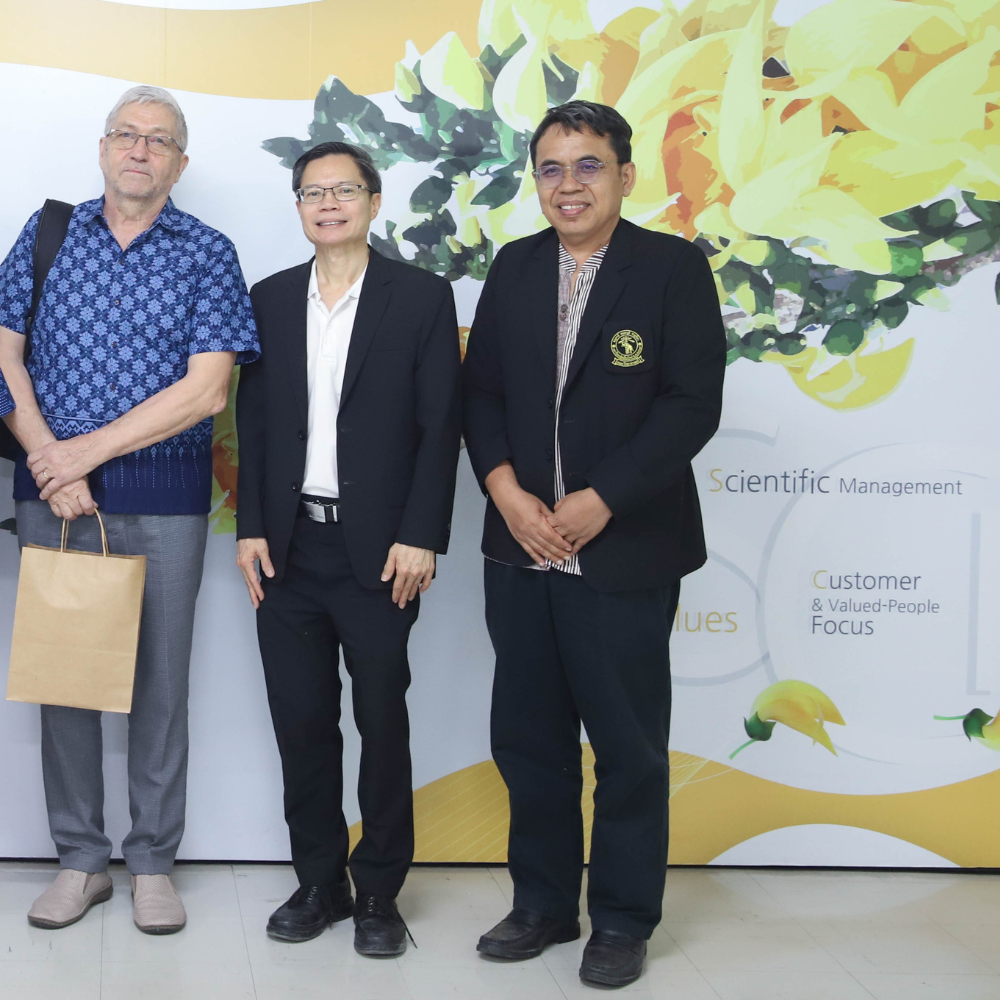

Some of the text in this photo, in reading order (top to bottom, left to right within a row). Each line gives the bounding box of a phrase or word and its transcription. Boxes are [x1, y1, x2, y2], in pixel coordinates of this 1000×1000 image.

[709, 468, 963, 497] Scientific Management
[812, 570, 922, 591] Customer
[811, 598, 940, 615] & Valued-People
[811, 615, 874, 636] Focus
